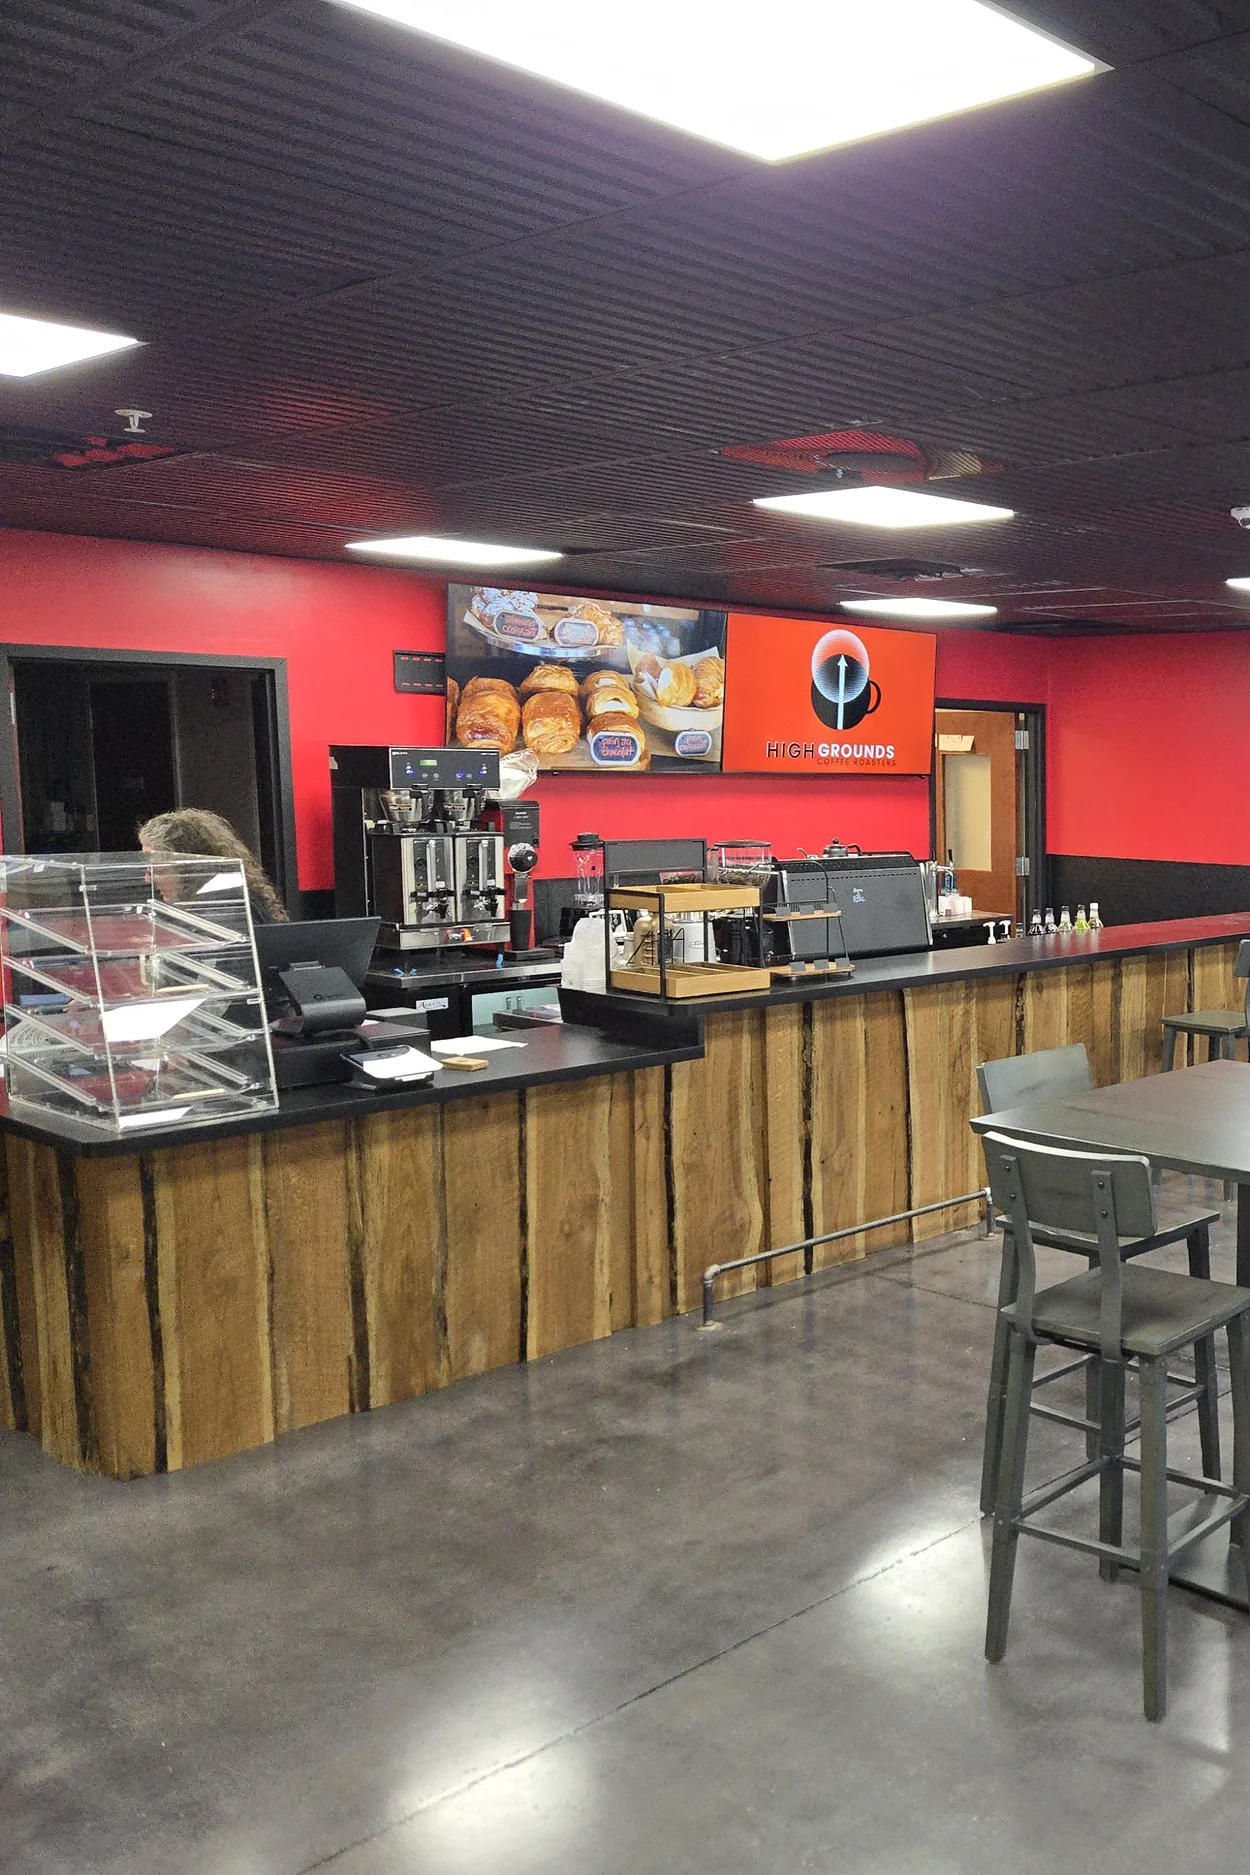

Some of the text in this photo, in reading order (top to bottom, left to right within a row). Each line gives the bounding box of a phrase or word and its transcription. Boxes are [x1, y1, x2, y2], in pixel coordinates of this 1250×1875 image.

[602, 737, 632, 748] pain au
[766, 741, 895, 759] HIGH GROUNDS
[817, 758, 897, 767] COFFEE ROASTERS
